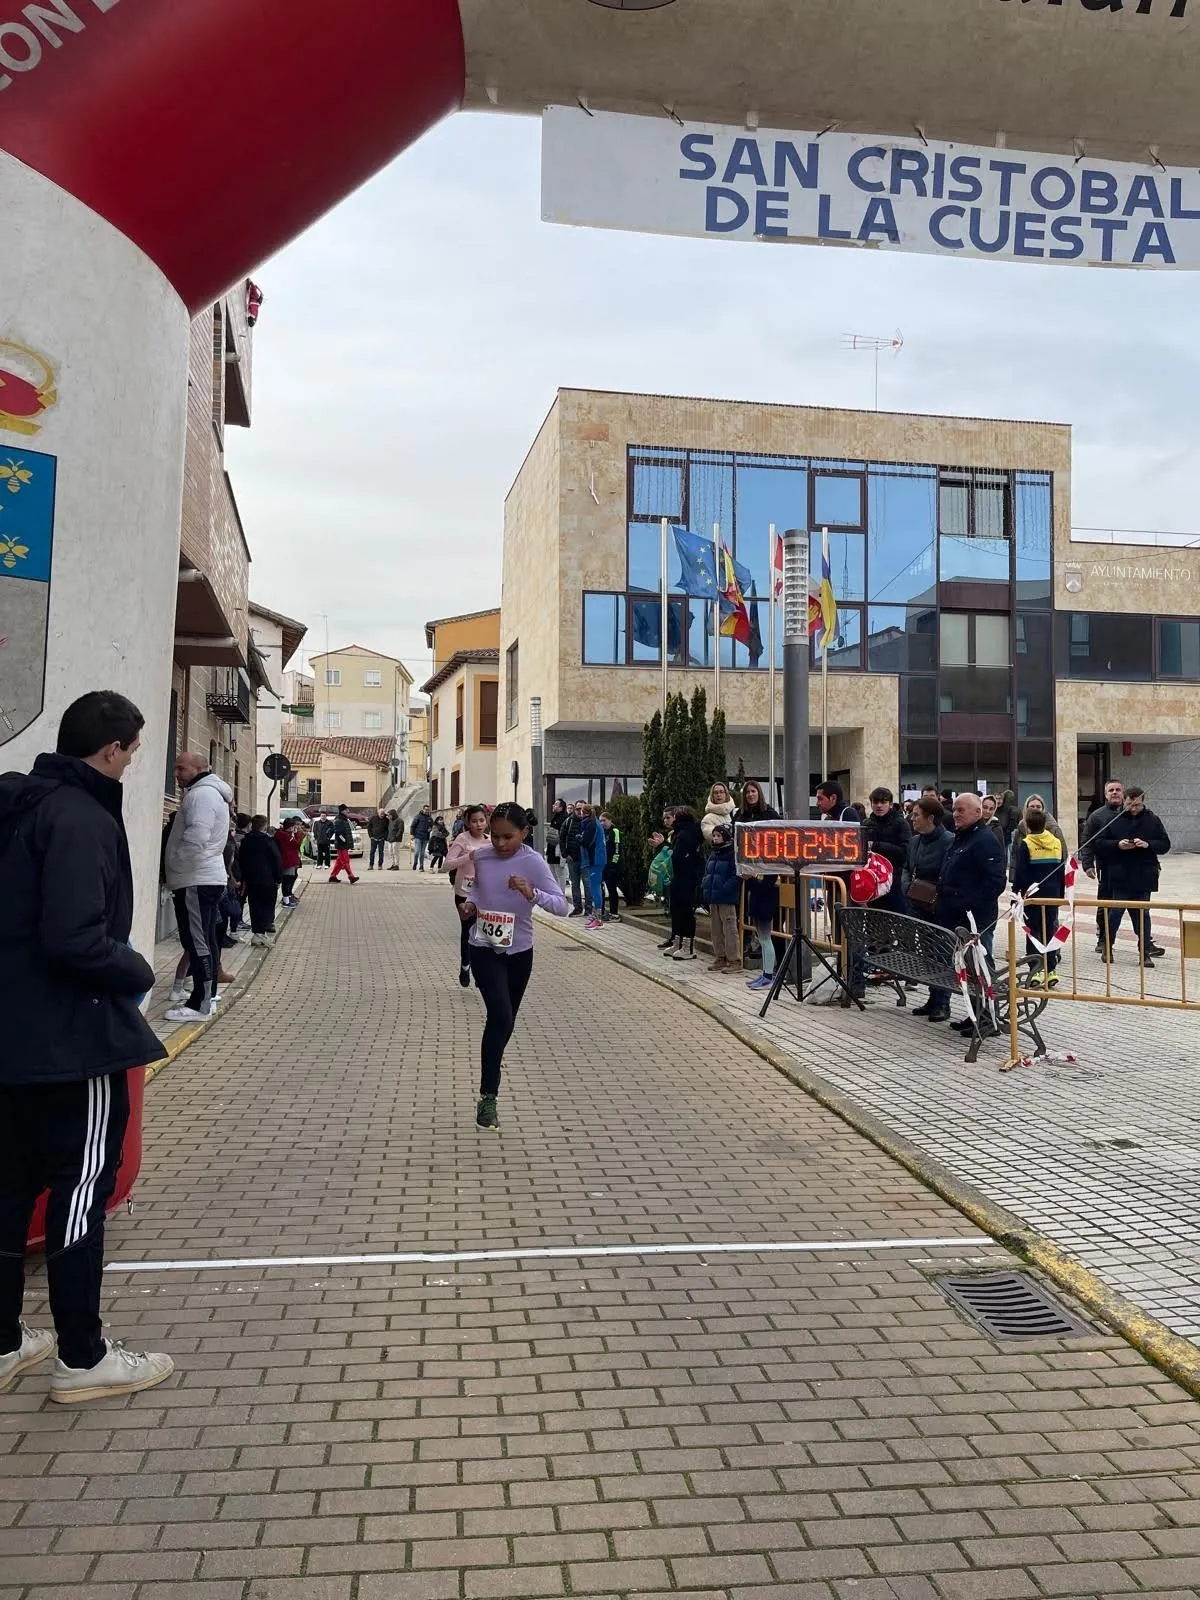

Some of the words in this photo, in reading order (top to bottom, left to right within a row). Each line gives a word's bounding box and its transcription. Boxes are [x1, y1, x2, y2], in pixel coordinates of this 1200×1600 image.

[680, 134, 819, 189] SAN
[848, 147, 1200, 220] CRISTOBAL
[705, 187, 789, 236] DE
[818, 194, 900, 241] LA
[929, 205, 1176, 263] CUESTA
[1090, 565, 1191, 580] AYUNTAMIENTO
[482, 921, 503, 937] 436
